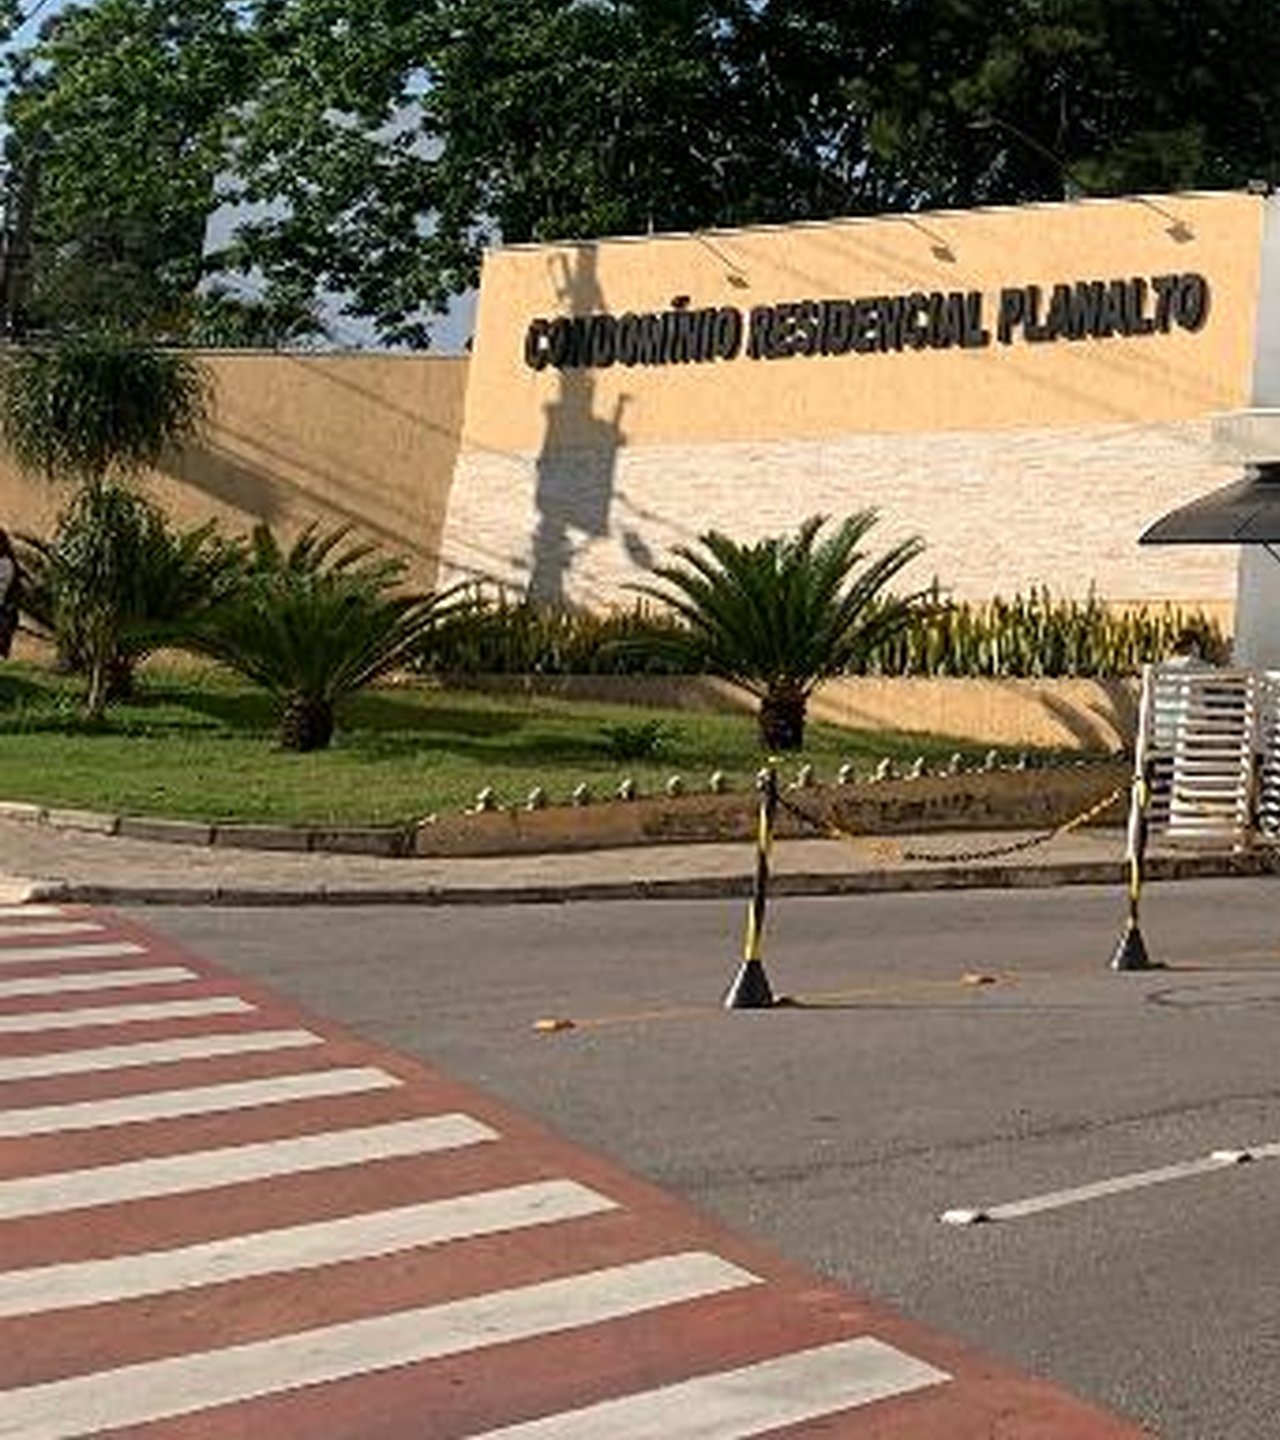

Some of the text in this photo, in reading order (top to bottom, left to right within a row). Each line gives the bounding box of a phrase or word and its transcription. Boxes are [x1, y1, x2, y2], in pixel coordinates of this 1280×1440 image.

[525, 273, 1211, 370] CONDOMÍNIO RESIDENCIAL PLANALTO
